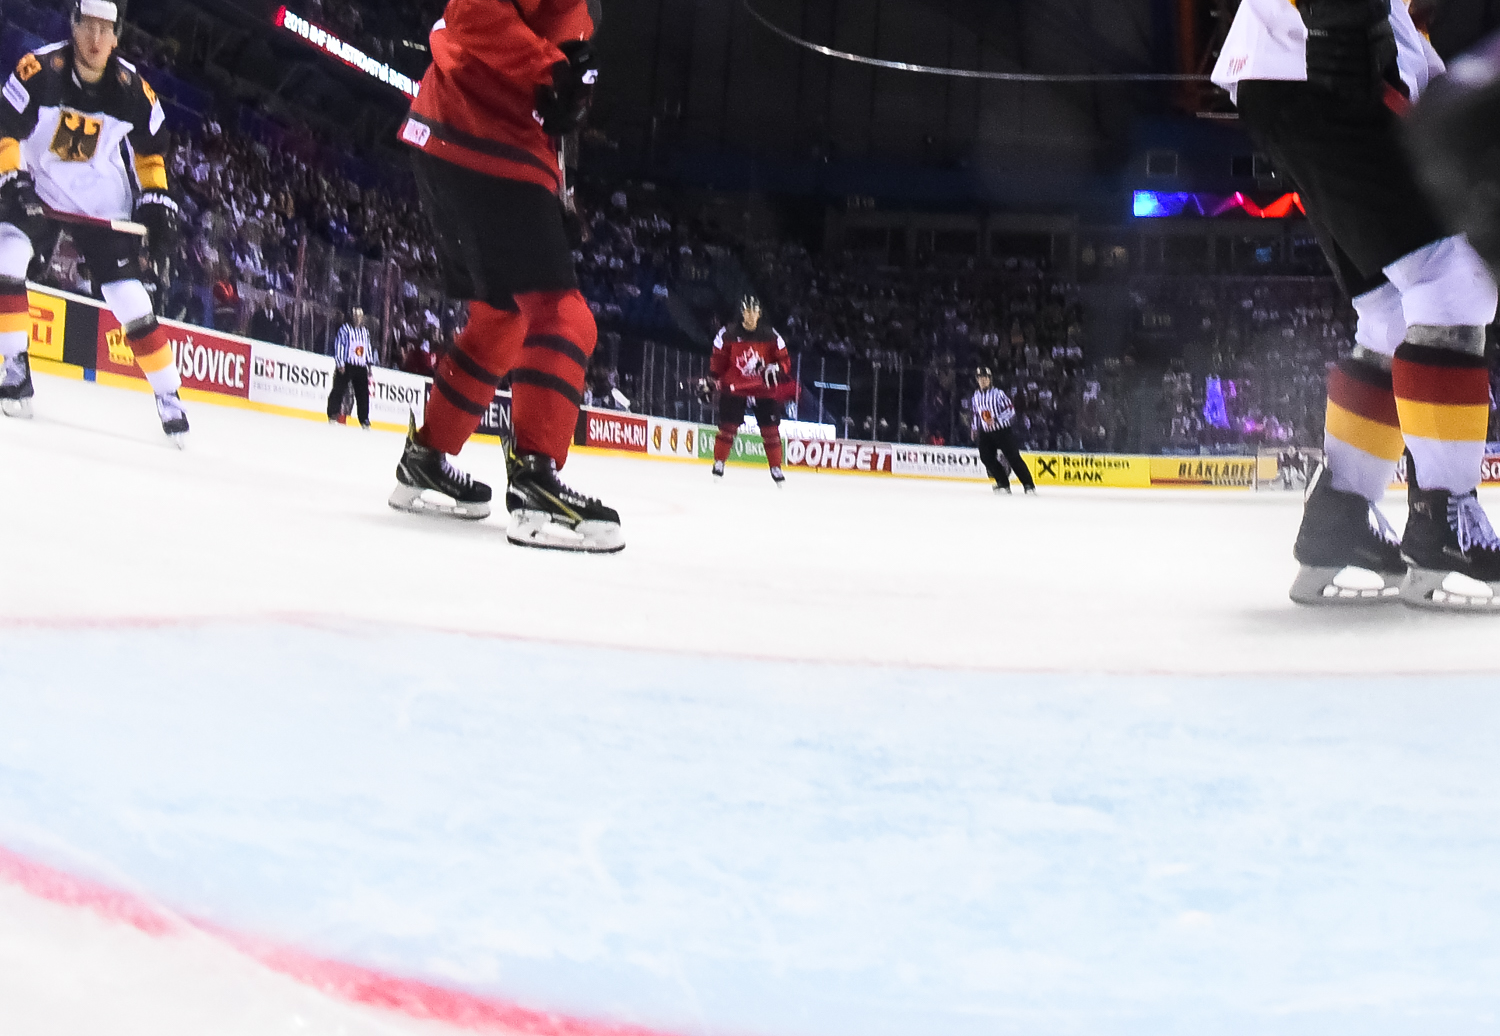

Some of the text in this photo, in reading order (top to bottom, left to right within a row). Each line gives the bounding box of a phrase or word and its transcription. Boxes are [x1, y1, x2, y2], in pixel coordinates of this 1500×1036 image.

[277, 362, 330, 390] TISSOT
[377, 382, 422, 406] TISSOT
[589, 418, 646, 447] SHATE-M.RU
[787, 439, 891, 472] ФОНБЕТ
[922, 452, 980, 467] TISSOT
[1063, 455, 1130, 470] Raiffeisen
[1064, 470, 1103, 482] BANK
